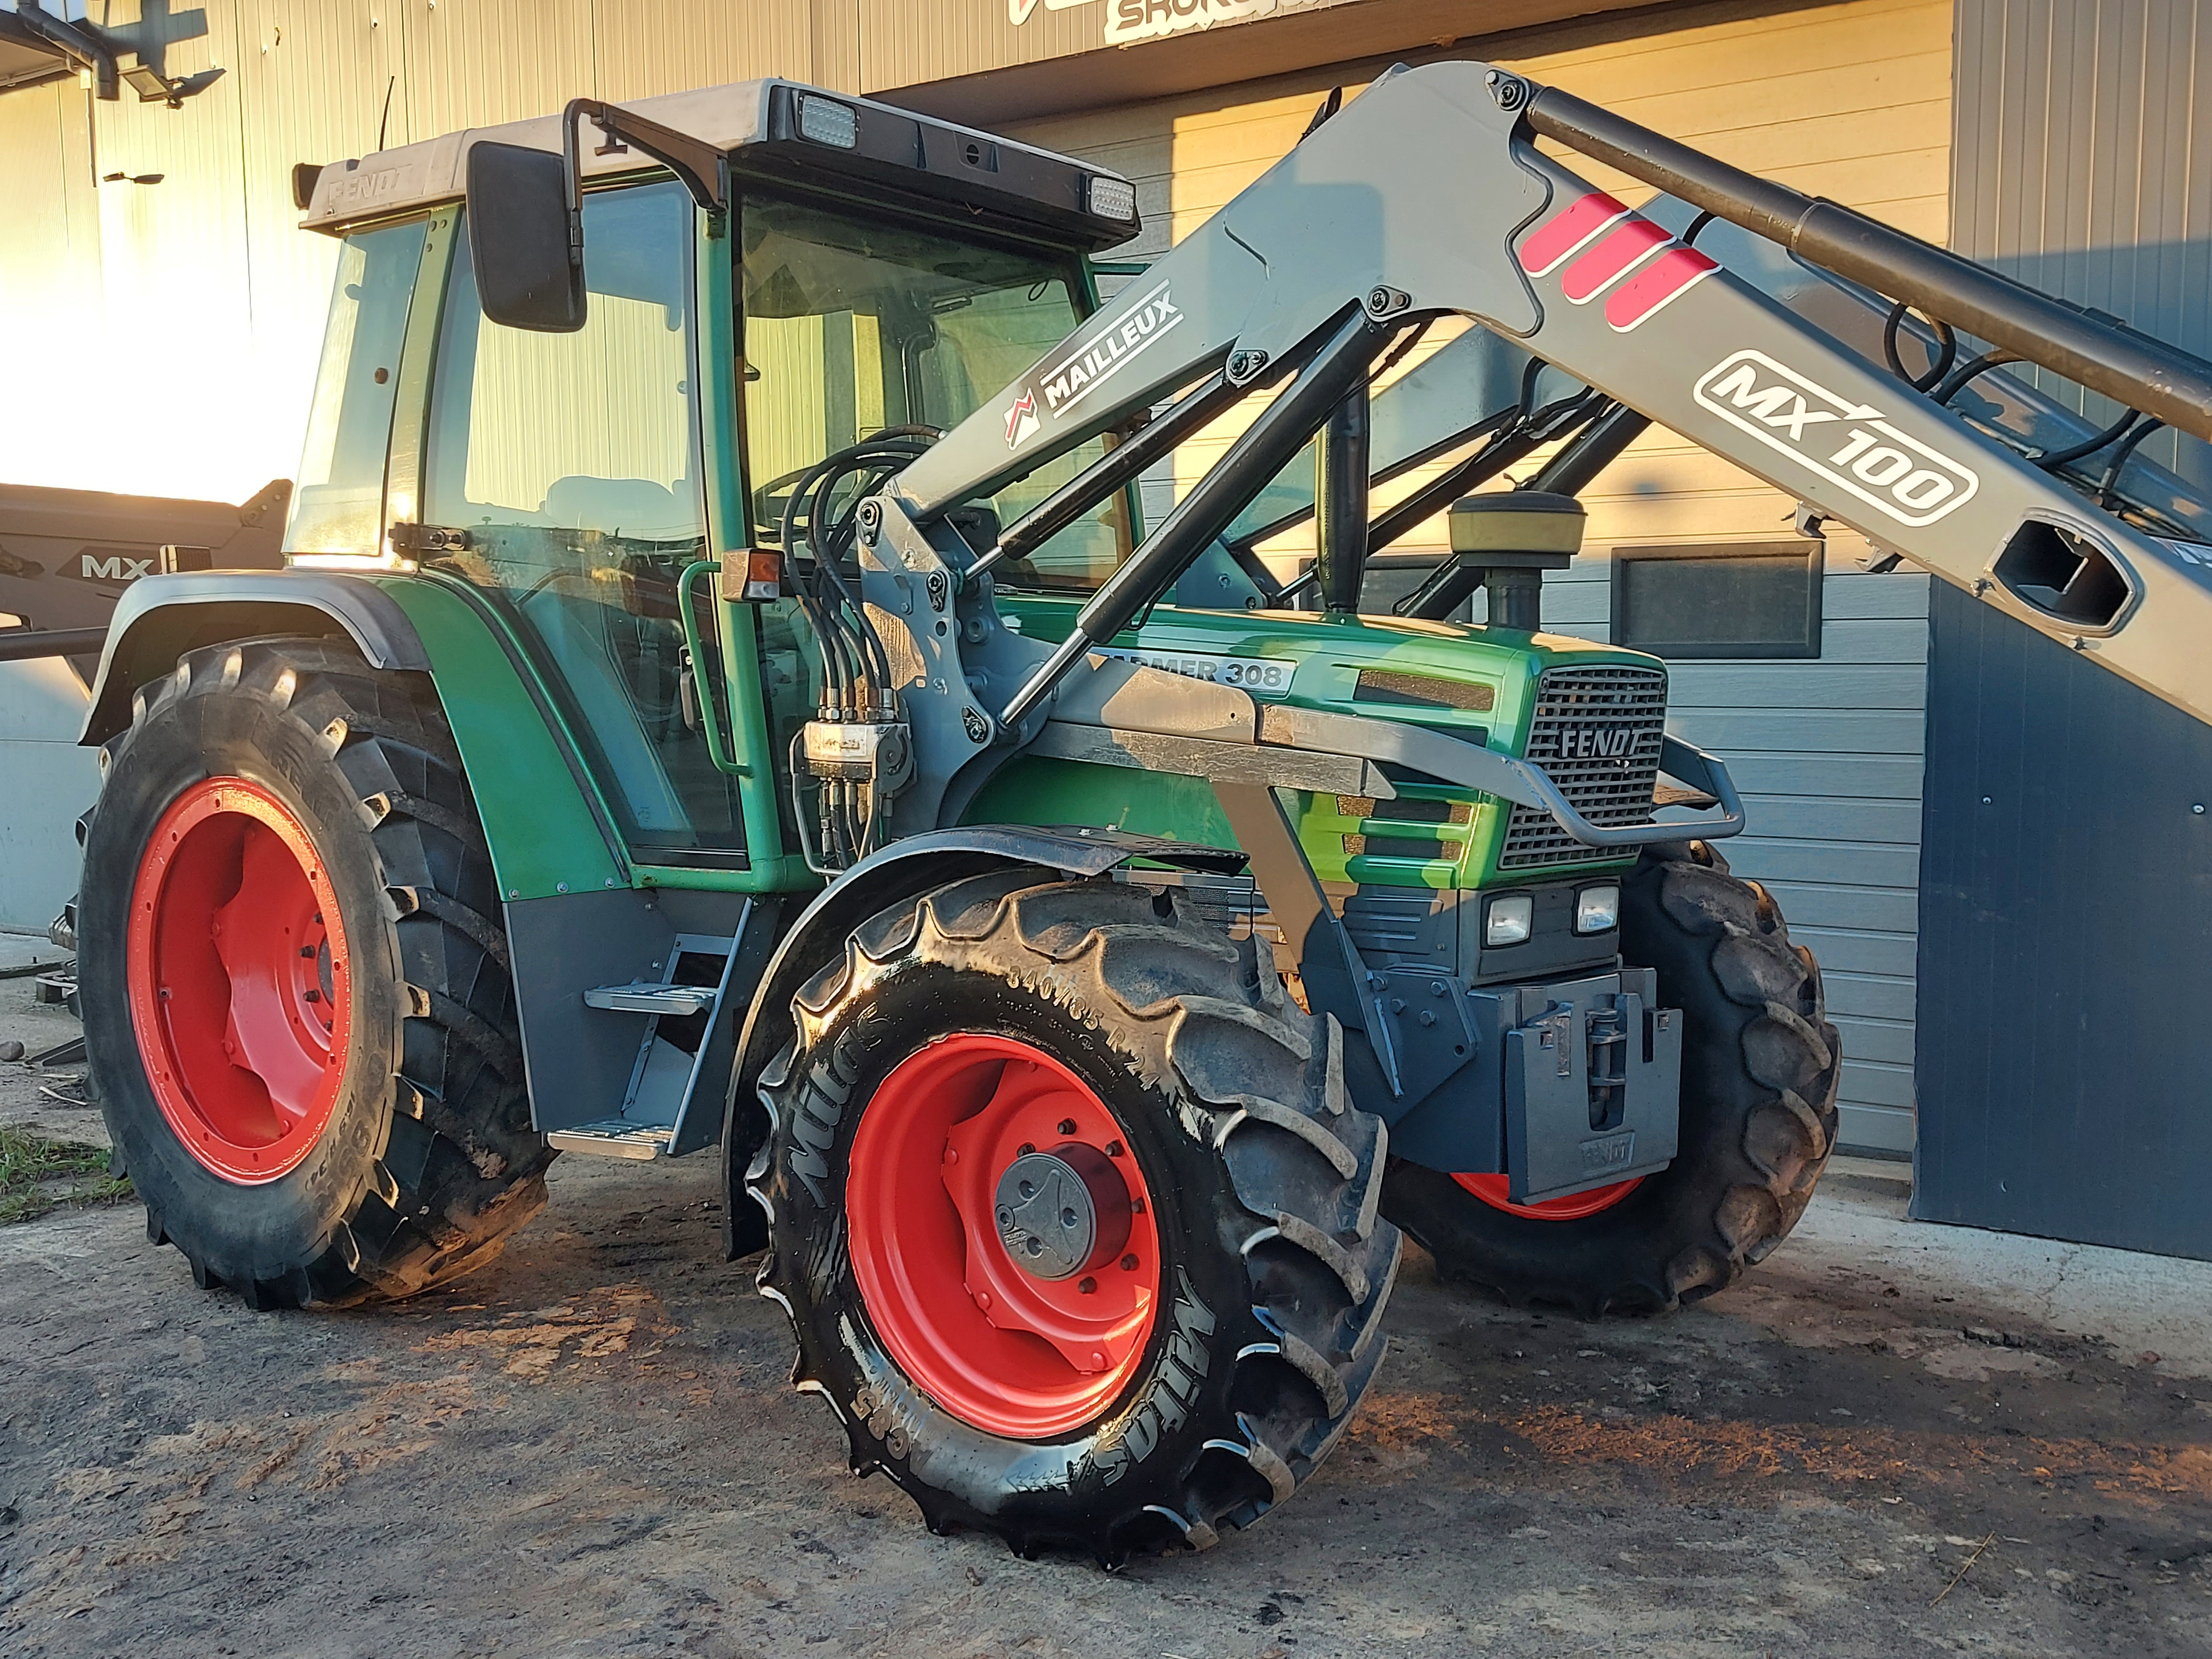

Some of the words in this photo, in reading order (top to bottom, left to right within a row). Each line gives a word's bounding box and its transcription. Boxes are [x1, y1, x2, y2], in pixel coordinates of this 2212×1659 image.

[329, 164, 414, 206] FENDT
[1044, 289, 1179, 409] MAILLEUX
[1710, 364, 1842, 442] MX
[1828, 428, 1955, 509] 100
[82, 555, 154, 580] MX
[1225, 664, 1283, 687] 308
[1561, 729, 1643, 758] FENDT
[787, 1001, 892, 1208] Mitas
[1094, 1264, 1217, 1487] Mitas
